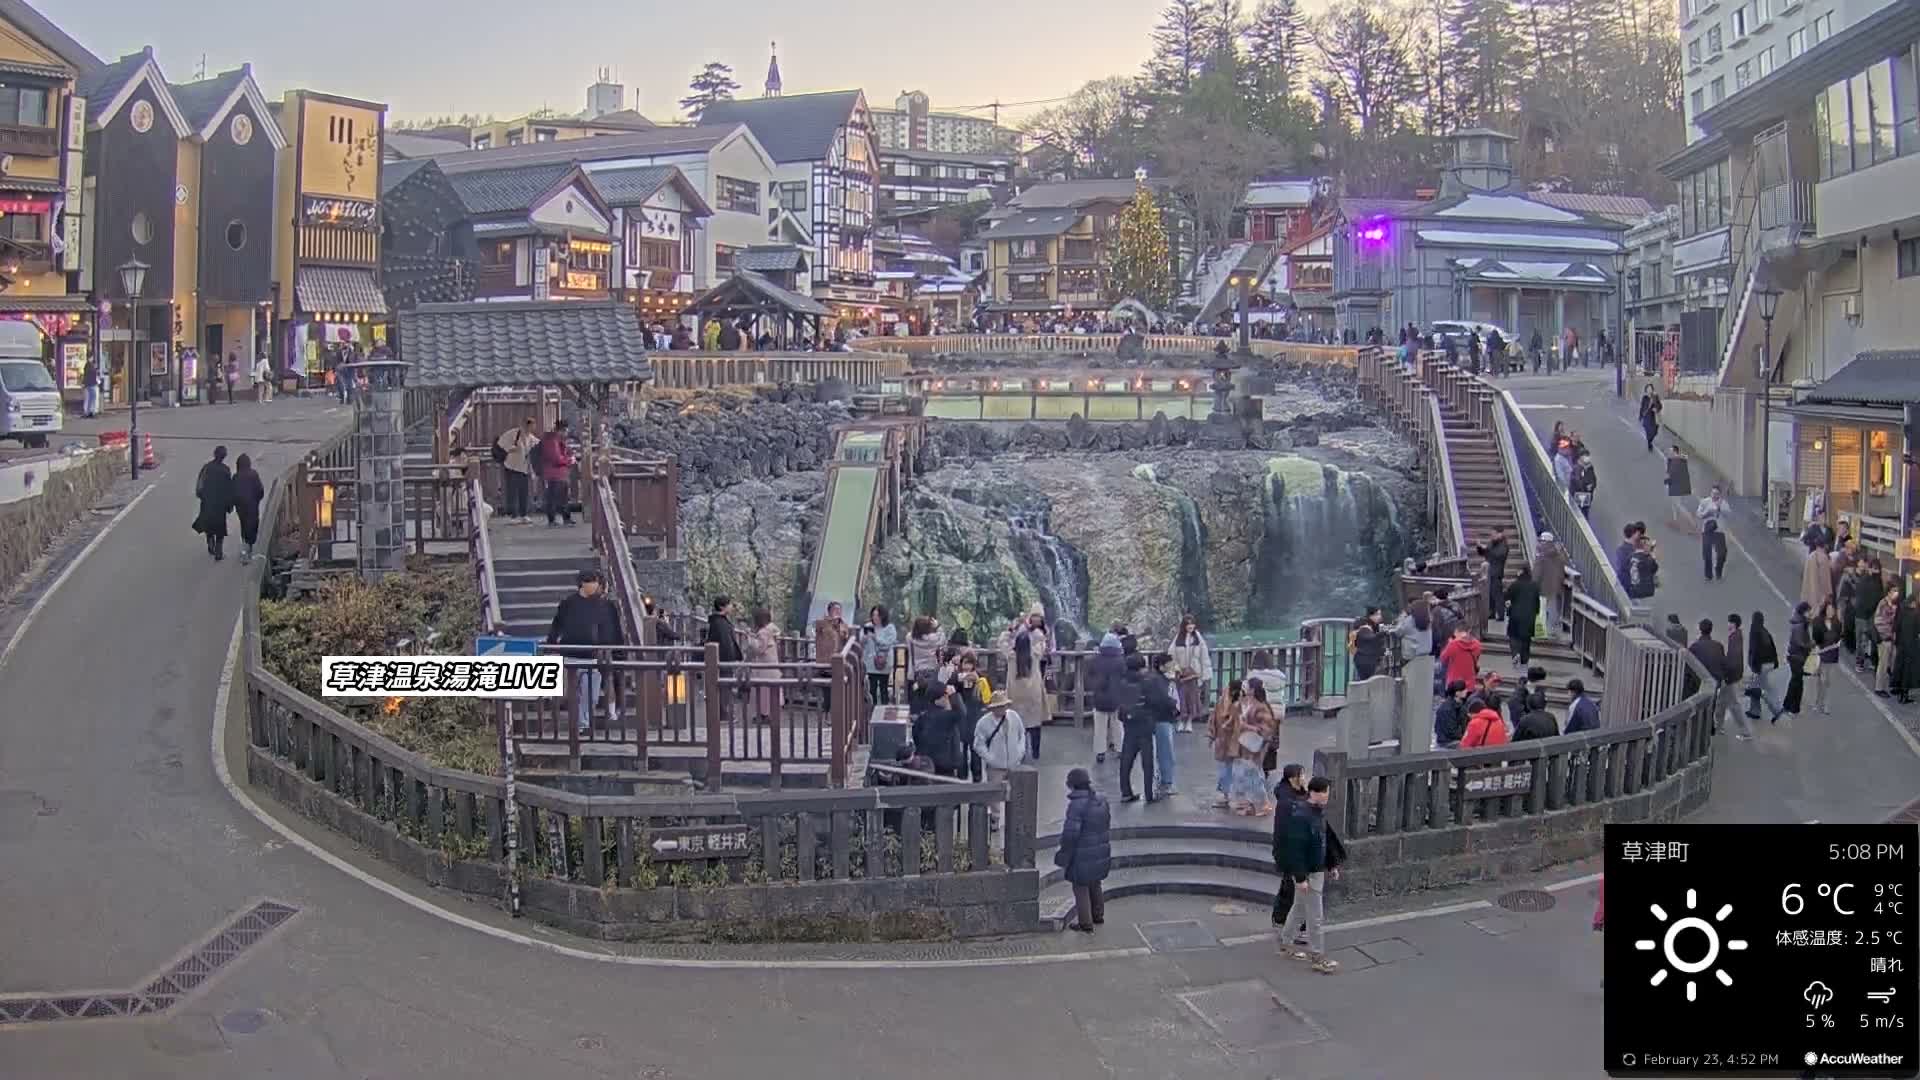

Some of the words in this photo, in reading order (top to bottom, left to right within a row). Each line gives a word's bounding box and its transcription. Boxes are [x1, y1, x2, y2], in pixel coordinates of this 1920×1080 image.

[678, 835, 705, 852] 東京
[707, 832, 747, 851] 軽井沢
